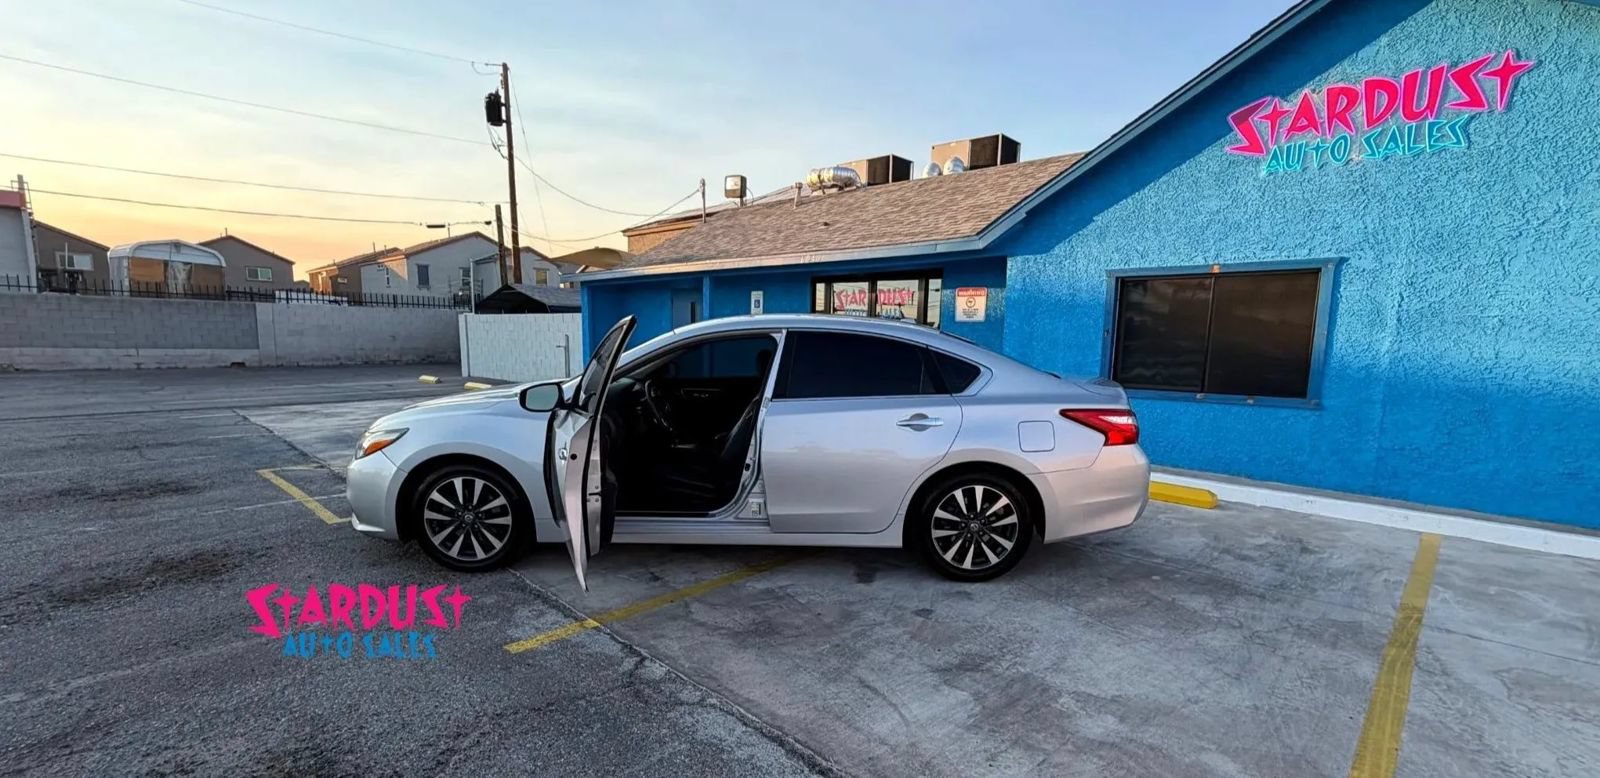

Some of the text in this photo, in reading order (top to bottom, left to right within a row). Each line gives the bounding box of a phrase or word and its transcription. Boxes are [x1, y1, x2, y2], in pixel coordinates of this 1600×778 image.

[1226, 49, 1535, 156] STARDUST
[1263, 115, 1469, 174] AUTO SALES
